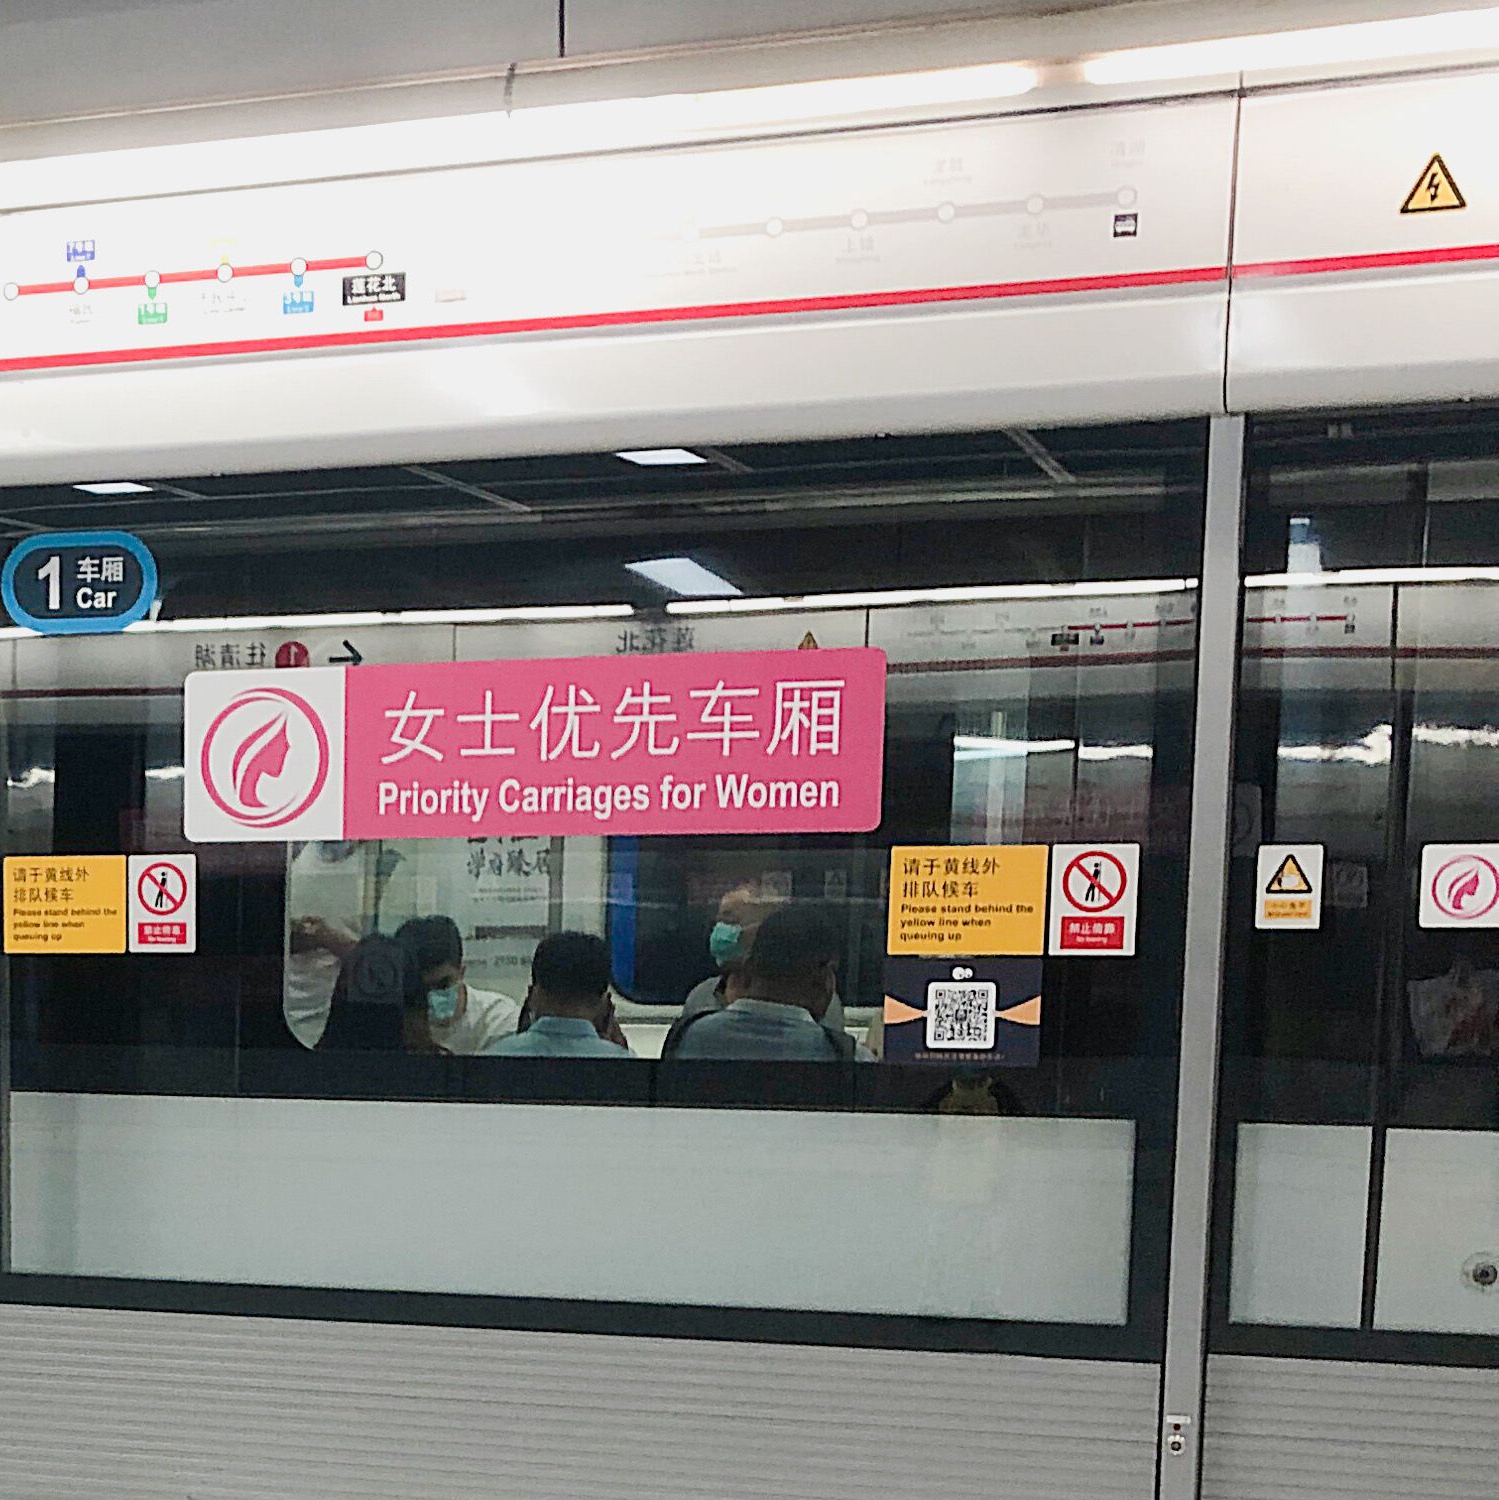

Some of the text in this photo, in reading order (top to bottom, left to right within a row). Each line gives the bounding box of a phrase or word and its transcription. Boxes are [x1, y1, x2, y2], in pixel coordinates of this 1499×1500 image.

[76, 556, 124, 584] 车厢
[37, 555, 61, 610] 1
[76, 588, 116, 609] Car
[381, 678, 846, 764] 女士优先车厢
[378, 773, 839, 823] Priority Carriages for Women
[903, 857, 1000, 876] 请于黄线外
[903, 880, 979, 898] 排队候车
[901, 903, 1034, 914] Please stand behind the
[900, 917, 991, 928] yellow line when
[947, 932, 962, 942] up
